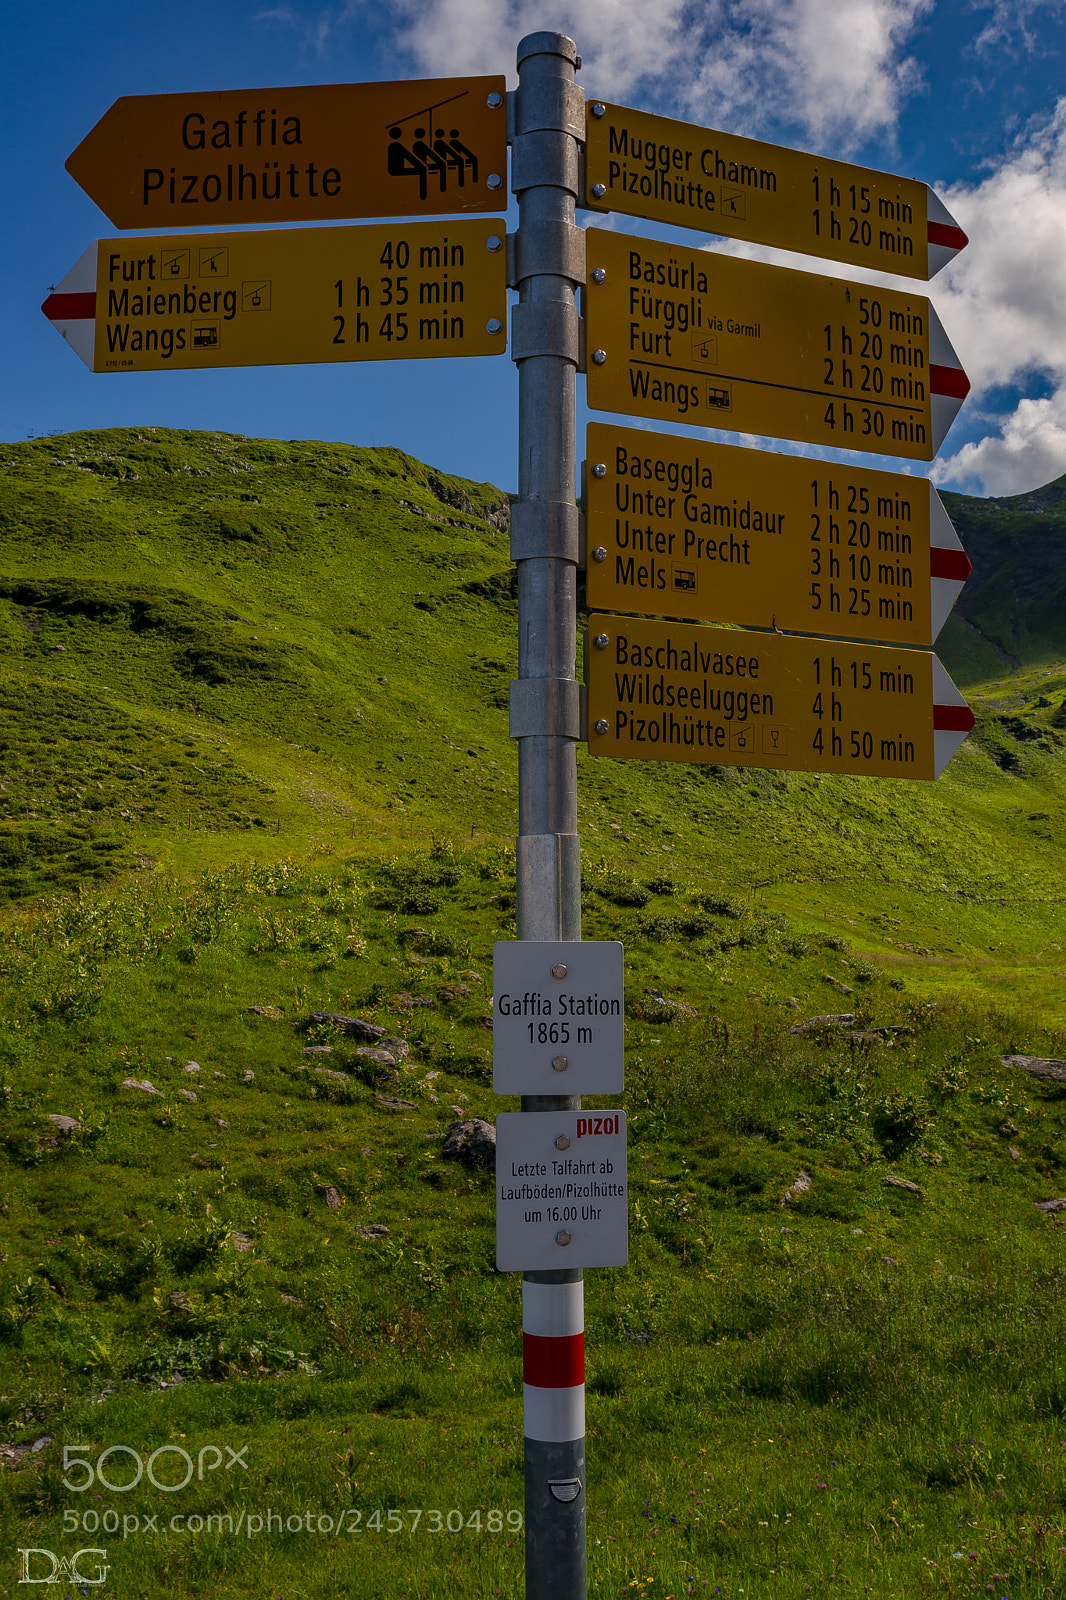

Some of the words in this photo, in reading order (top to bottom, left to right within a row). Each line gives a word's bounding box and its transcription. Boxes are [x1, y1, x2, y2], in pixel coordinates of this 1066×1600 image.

[182, 109, 303, 150] Gaffia
[608, 125, 693, 172] Mugger
[701, 149, 776, 192] Chamm
[143, 162, 341, 205] Pizolhütte
[608, 160, 716, 212] Pizolhütte
[812, 176, 819, 202] 1
[830, 178, 840, 207] h
[849, 185, 870, 213] 15
[879, 194, 913, 224] min
[813, 209, 819, 235] 1
[831, 211, 841, 240] h
[849, 217, 871, 246] 20
[880, 227, 913, 256] min
[109, 254, 156, 282] Furt
[380, 241, 409, 270] 40
[420, 238, 464, 268] min
[630, 251, 707, 294] Basürla
[108, 284, 236, 320] Maienberg
[334, 280, 342, 308] 1
[357, 277, 369, 307] h
[380, 276, 409, 306] 35
[420, 273, 464, 304] min
[333, 315, 345, 344] 2
[356, 313, 369, 343] h
[379, 312, 408, 341] 45
[419, 309, 463, 340] min
[630, 287, 701, 332] Fürggli
[708, 316, 723, 331] via
[727, 319, 760, 338] Garmil
[860, 298, 881, 327] 50
[889, 307, 923, 336] min
[106, 324, 186, 358] Wangs
[630, 322, 672, 357] Furt
[824, 325, 831, 351] 1
[842, 326, 852, 355] h
[860, 331, 882, 360] 20
[890, 339, 924, 368] min
[629, 368, 699, 413] Wangs
[824, 358, 834, 385] 2
[842, 359, 853, 389] h
[861, 365, 883, 393] 20
[891, 372, 924, 401] min
[824, 402, 836, 429] 4
[843, 403, 853, 432] h
[862, 408, 884, 437] 30
[892, 415, 926, 444] min
[616, 446, 712, 494] Baseggla
[616, 483, 675, 519] Unter
[684, 494, 785, 535] Gamidaur
[811, 480, 818, 507] 1
[829, 481, 839, 510] h
[848, 485, 869, 514] 25
[877, 492, 911, 521] min
[616, 519, 675, 554] Unter
[685, 529, 750, 565] Precht
[811, 514, 820, 541] 2
[829, 514, 839, 544] h
[848, 519, 870, 548] 20
[878, 525, 911, 554] min
[616, 556, 666, 589] Mels
[811, 548, 821, 575] 3
[830, 549, 840, 578] h
[849, 554, 870, 582] 10
[878, 559, 912, 588] min
[812, 583, 821, 610] 5
[830, 583, 840, 612] h
[849, 588, 871, 616] 25
[879, 592, 912, 621] min
[616, 636, 759, 679] Baschalvasee
[813, 657, 820, 684] 1
[831, 657, 841, 687] h
[851, 662, 871, 690] 15
[880, 665, 913, 694] min
[615, 673, 773, 721] Wildseeluggen
[812, 692, 824, 720] 4
[832, 692, 842, 722] h
[616, 710, 725, 747] Pizolhütte
[813, 728, 824, 755] 4
[832, 727, 842, 757] h
[851, 731, 873, 759] 50
[881, 734, 914, 762] min
[499, 992, 551, 1015] Gaffia
[559, 993, 620, 1015] Station
[528, 1022, 570, 1044] 1865
[578, 1028, 592, 1043] m
[512, 1162, 546, 1176] Letzte
[551, 1160, 596, 1175] Talfahrt
[600, 1159, 613, 1174] ab
[501, 1182, 624, 1200] Laufböden/Pizolhütte
[525, 1211, 542, 1222] um
[547, 1206, 577, 1222] 16.00
[582, 1205, 601, 1220] Uhr
